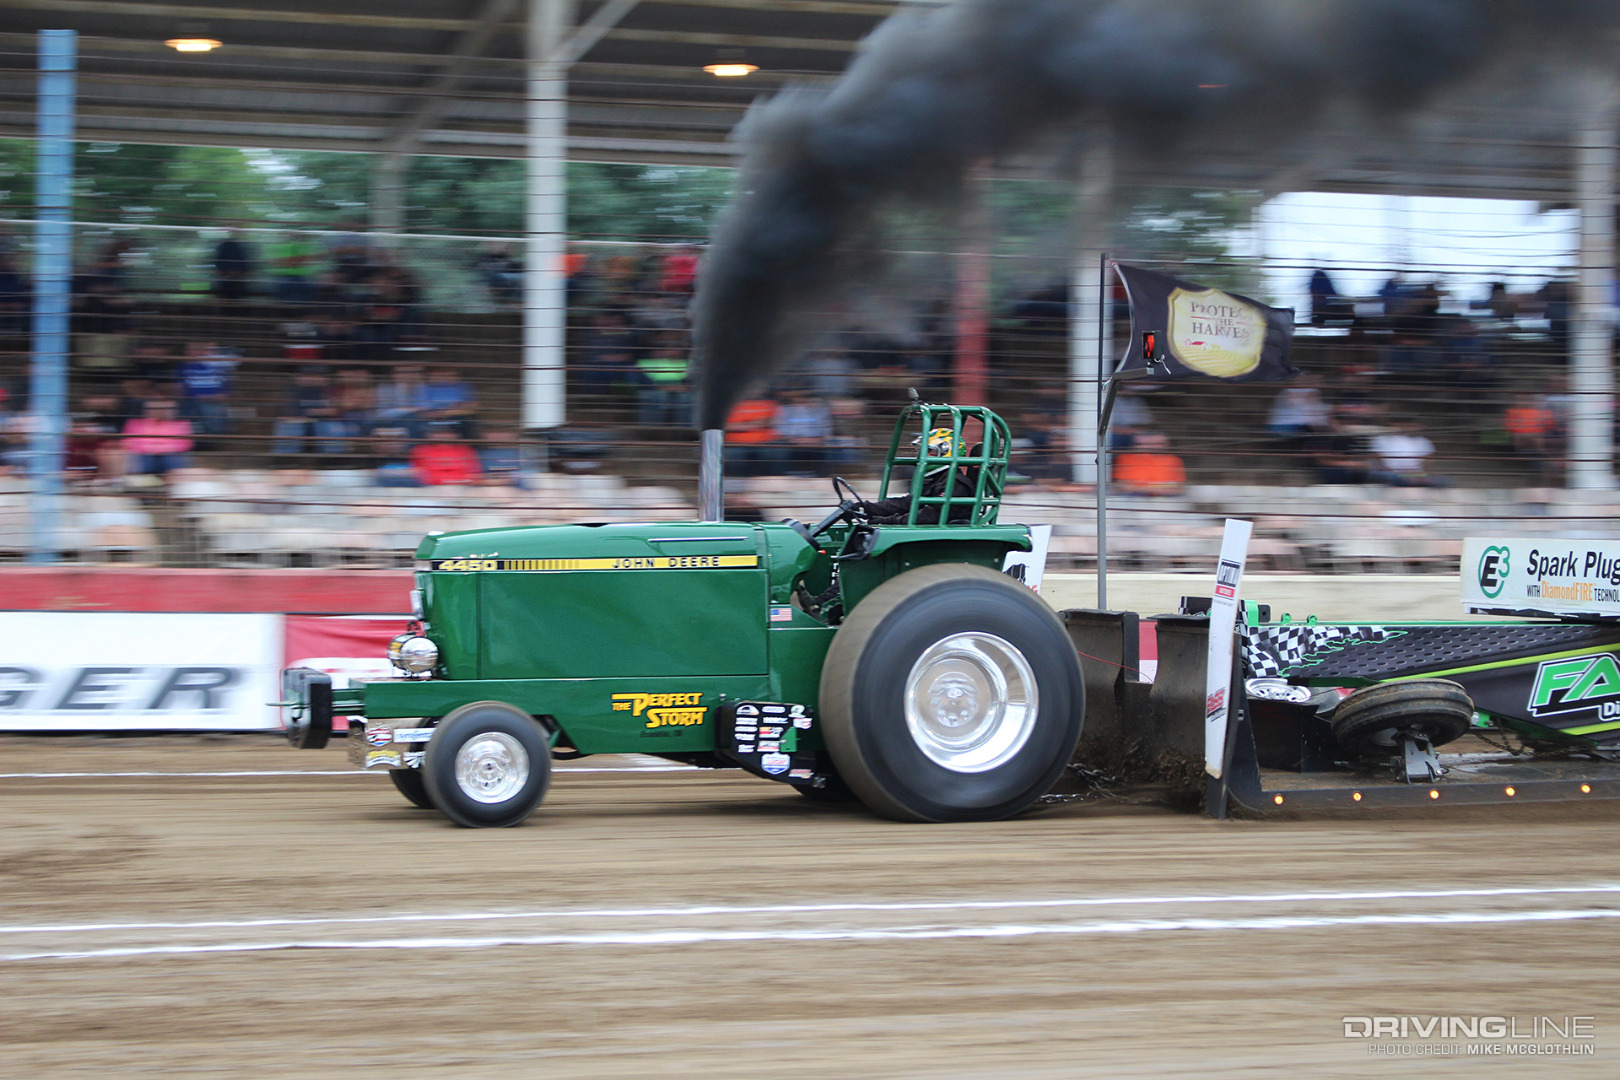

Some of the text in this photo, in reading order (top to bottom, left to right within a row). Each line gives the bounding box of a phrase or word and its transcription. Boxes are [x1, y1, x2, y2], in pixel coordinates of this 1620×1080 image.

[438, 560, 498, 571] 4450
[612, 556, 720, 569] JOHN DEERE
[1479, 545, 1511, 590] E3
[1526, 549, 1620, 586] Spark Plug
[1526, 584, 1541, 598] WITH
[611, 692, 704, 717] THE PERFECT
[645, 706, 708, 729] STORM
